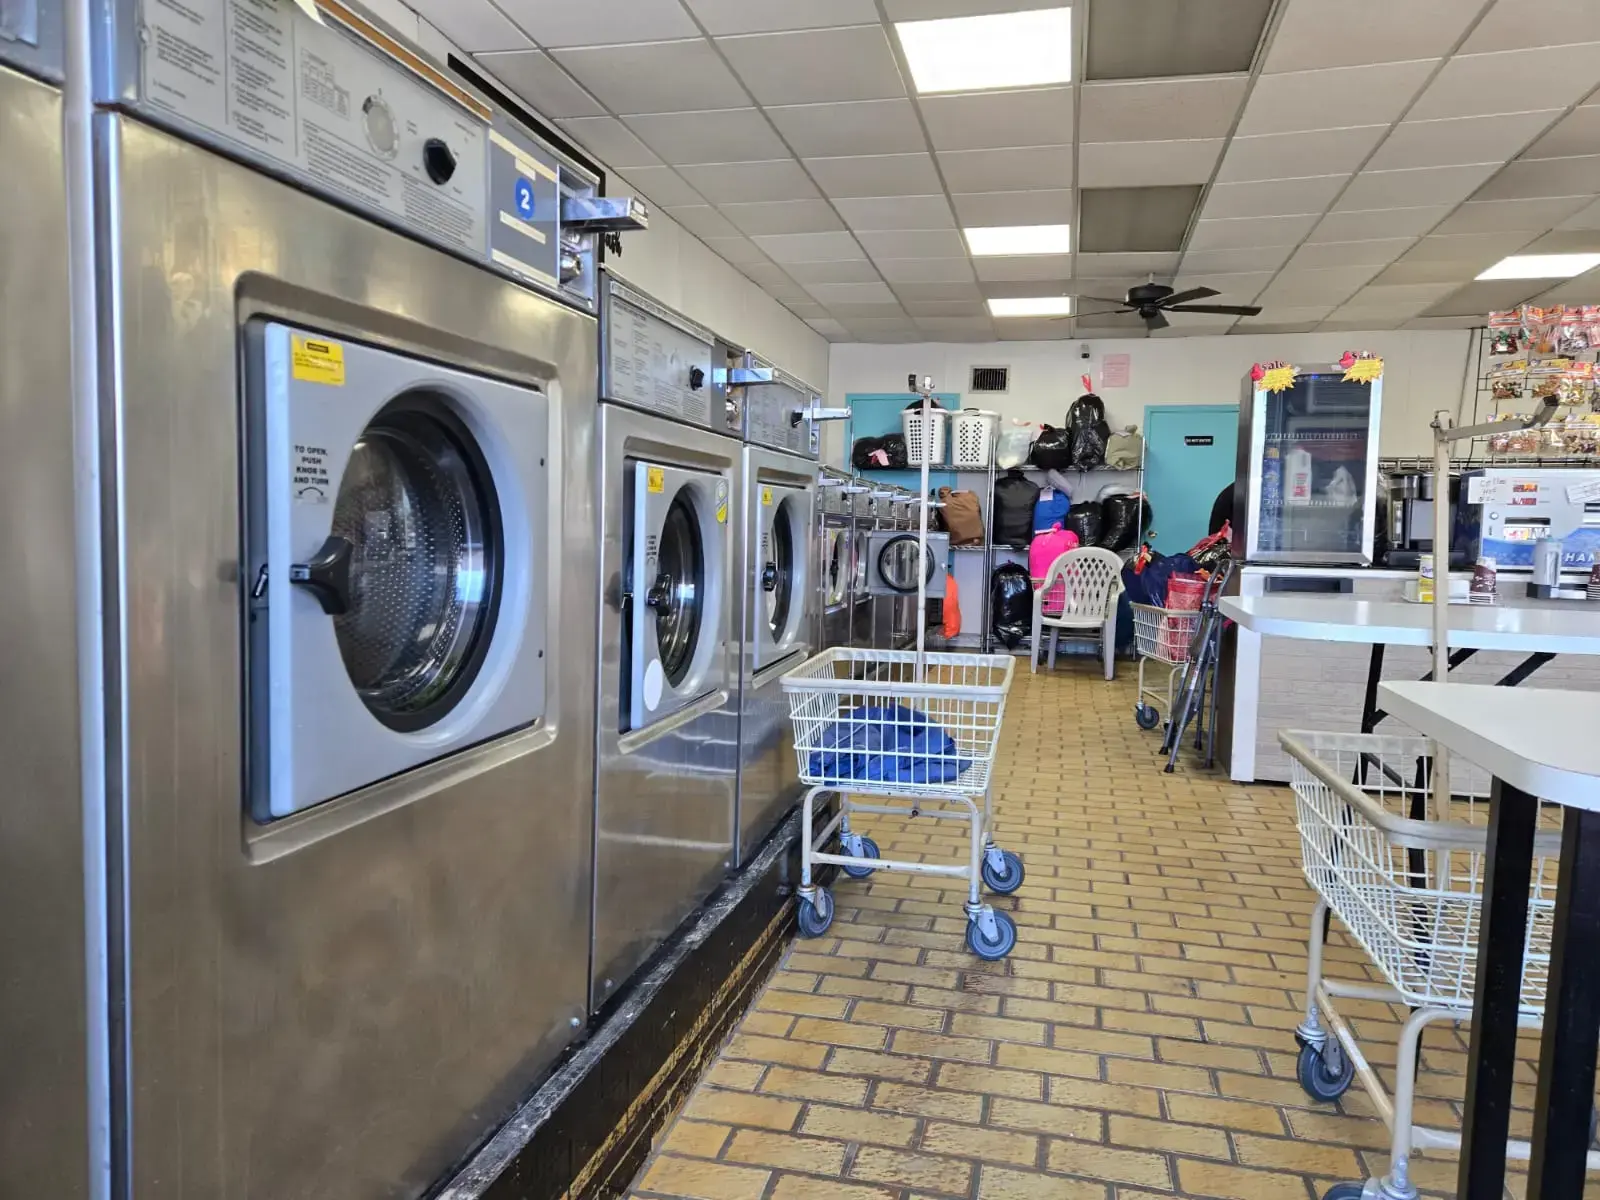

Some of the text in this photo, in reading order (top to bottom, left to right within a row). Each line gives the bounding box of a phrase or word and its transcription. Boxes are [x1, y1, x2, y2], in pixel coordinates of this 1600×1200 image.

[520, 188, 530, 210] 2
[295, 445, 305, 453] TO
[301, 456, 322, 464] PUSH
[296, 466, 317, 474] KNOB
